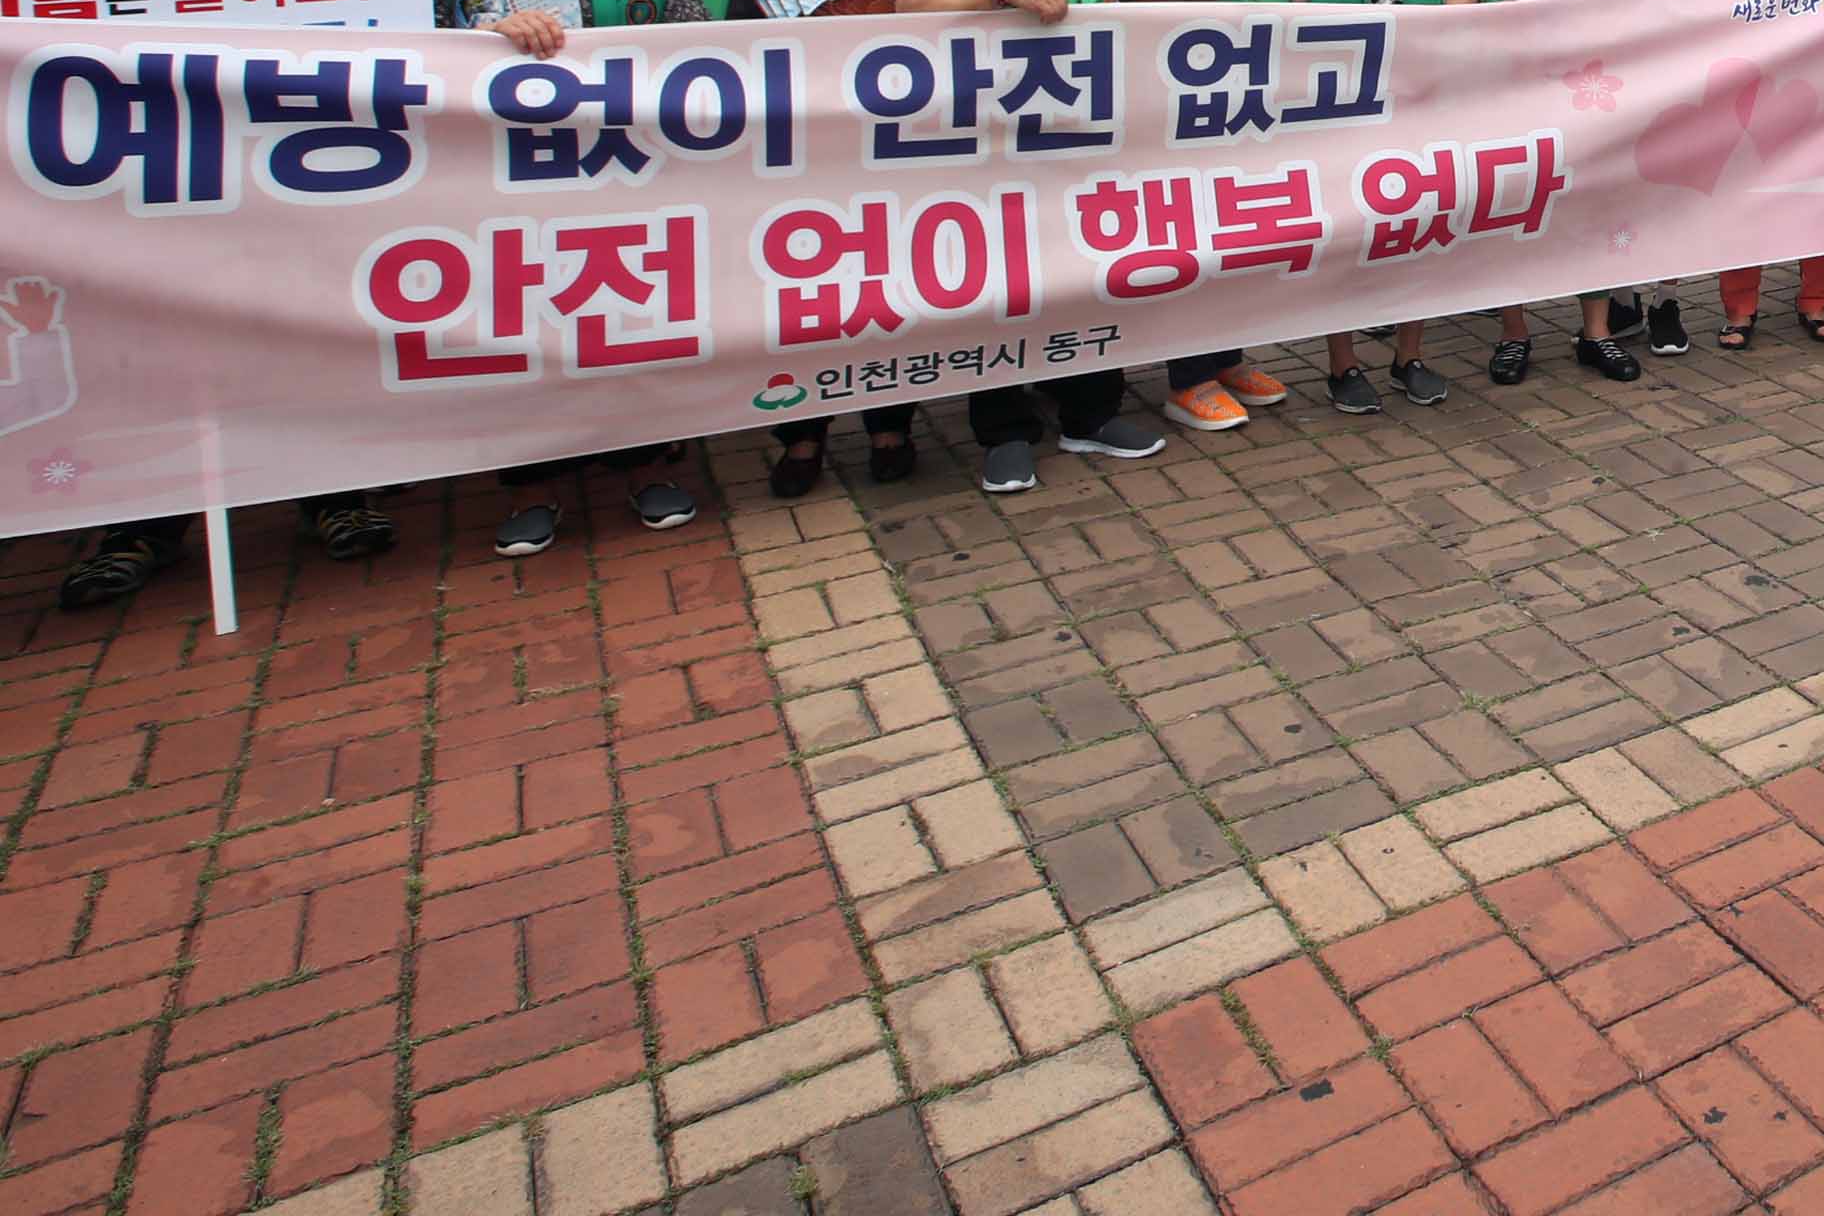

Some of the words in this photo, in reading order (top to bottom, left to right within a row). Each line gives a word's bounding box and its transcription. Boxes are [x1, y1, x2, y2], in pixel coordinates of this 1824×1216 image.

[27, 51, 428, 204] 예방
[488, 48, 792, 182] 없이
[854, 28, 1115, 160] 안전
[1167, 21, 1387, 141] 없고
[368, 216, 701, 382] 안전
[762, 192, 1032, 347] 없이
[1076, 169, 1325, 299] 행복
[1362, 135, 1566, 261] 없다
[815, 338, 1027, 400] 인천광역시
[1042, 324, 1122, 363] 동구
